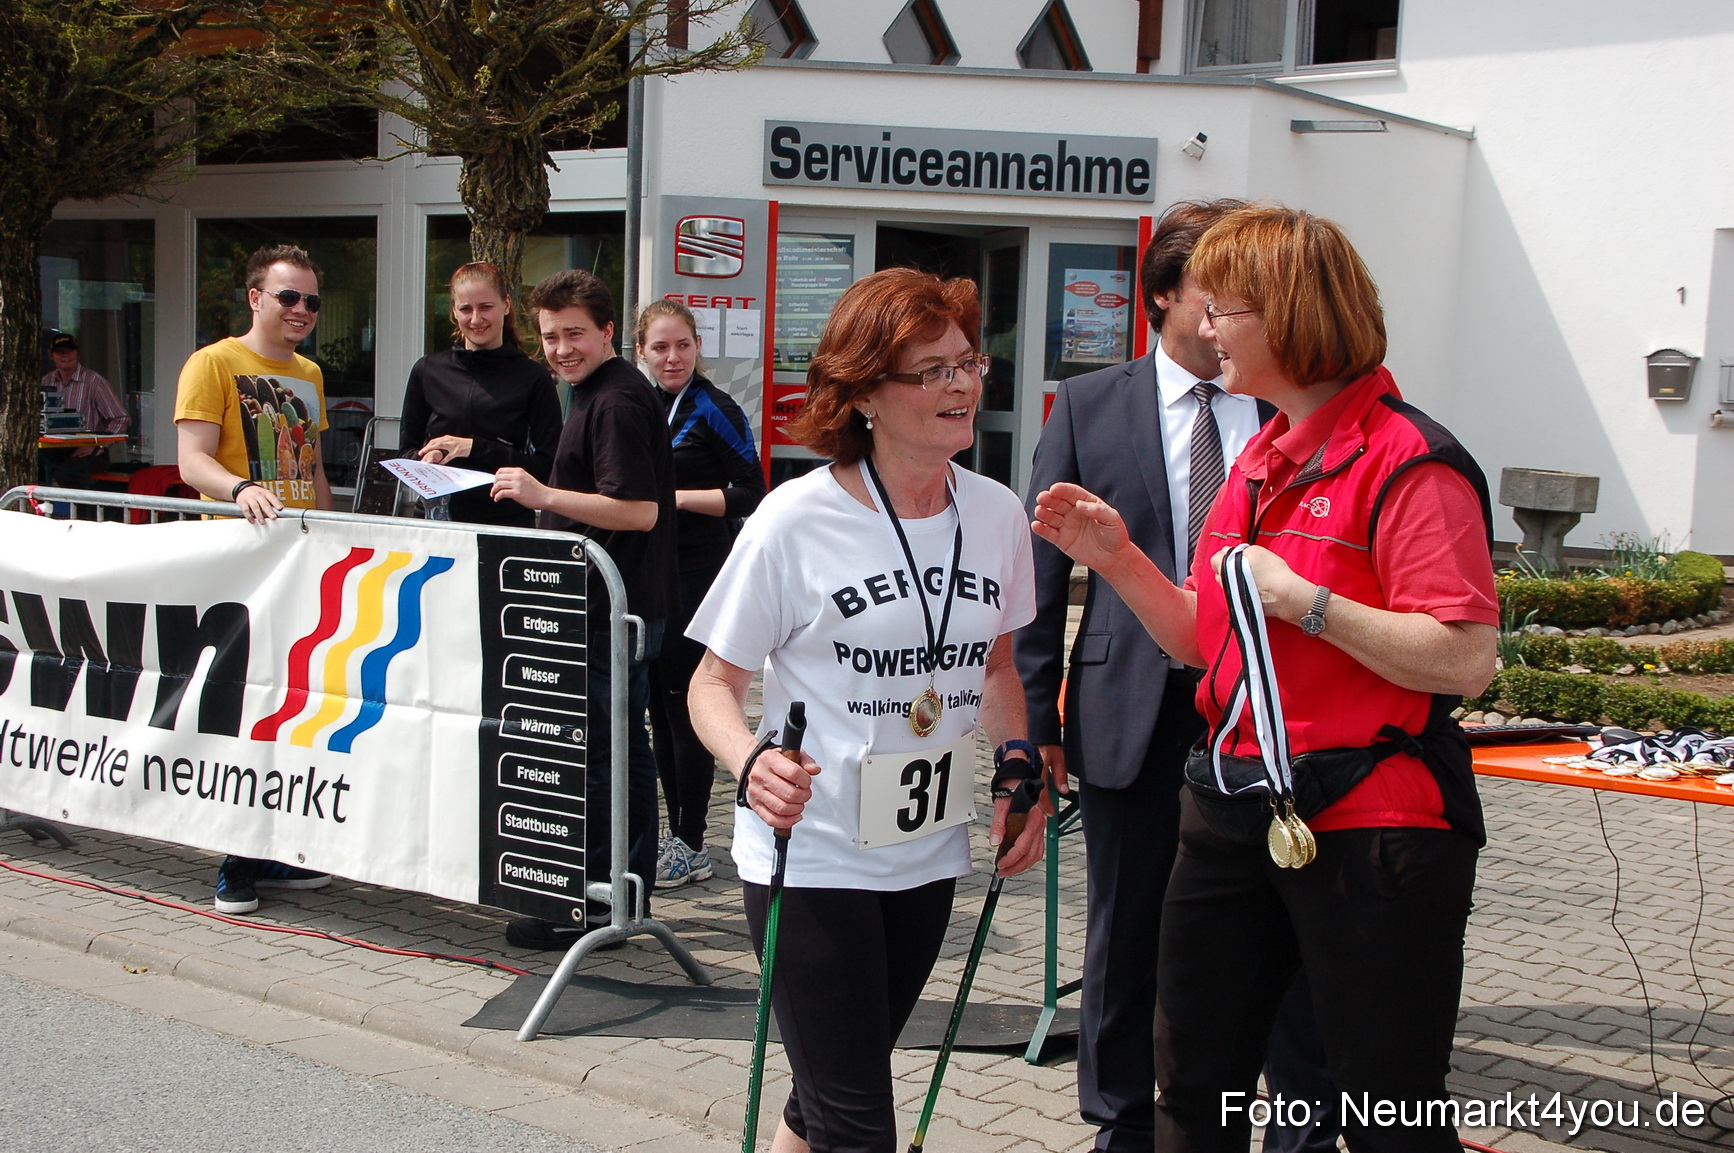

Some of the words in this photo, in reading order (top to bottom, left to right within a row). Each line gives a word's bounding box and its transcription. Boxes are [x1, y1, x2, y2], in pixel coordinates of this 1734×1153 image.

[770, 126, 1150, 196] Serviceannahme
[1677, 286, 1686, 305] 1
[523, 568, 561, 584] Strom
[523, 616, 559, 633] Erdgas
[938, 640, 993, 671] GIR
[521, 666, 561, 684] Wasser
[520, 717, 561, 736] Wärme
[516, 765, 561, 786] Freizeit
[143, 755, 351, 824] neumarkt
[896, 750, 953, 833] 31
[504, 813, 569, 838] Stadtbusse
[504, 863, 570, 888] Parkhäuser
